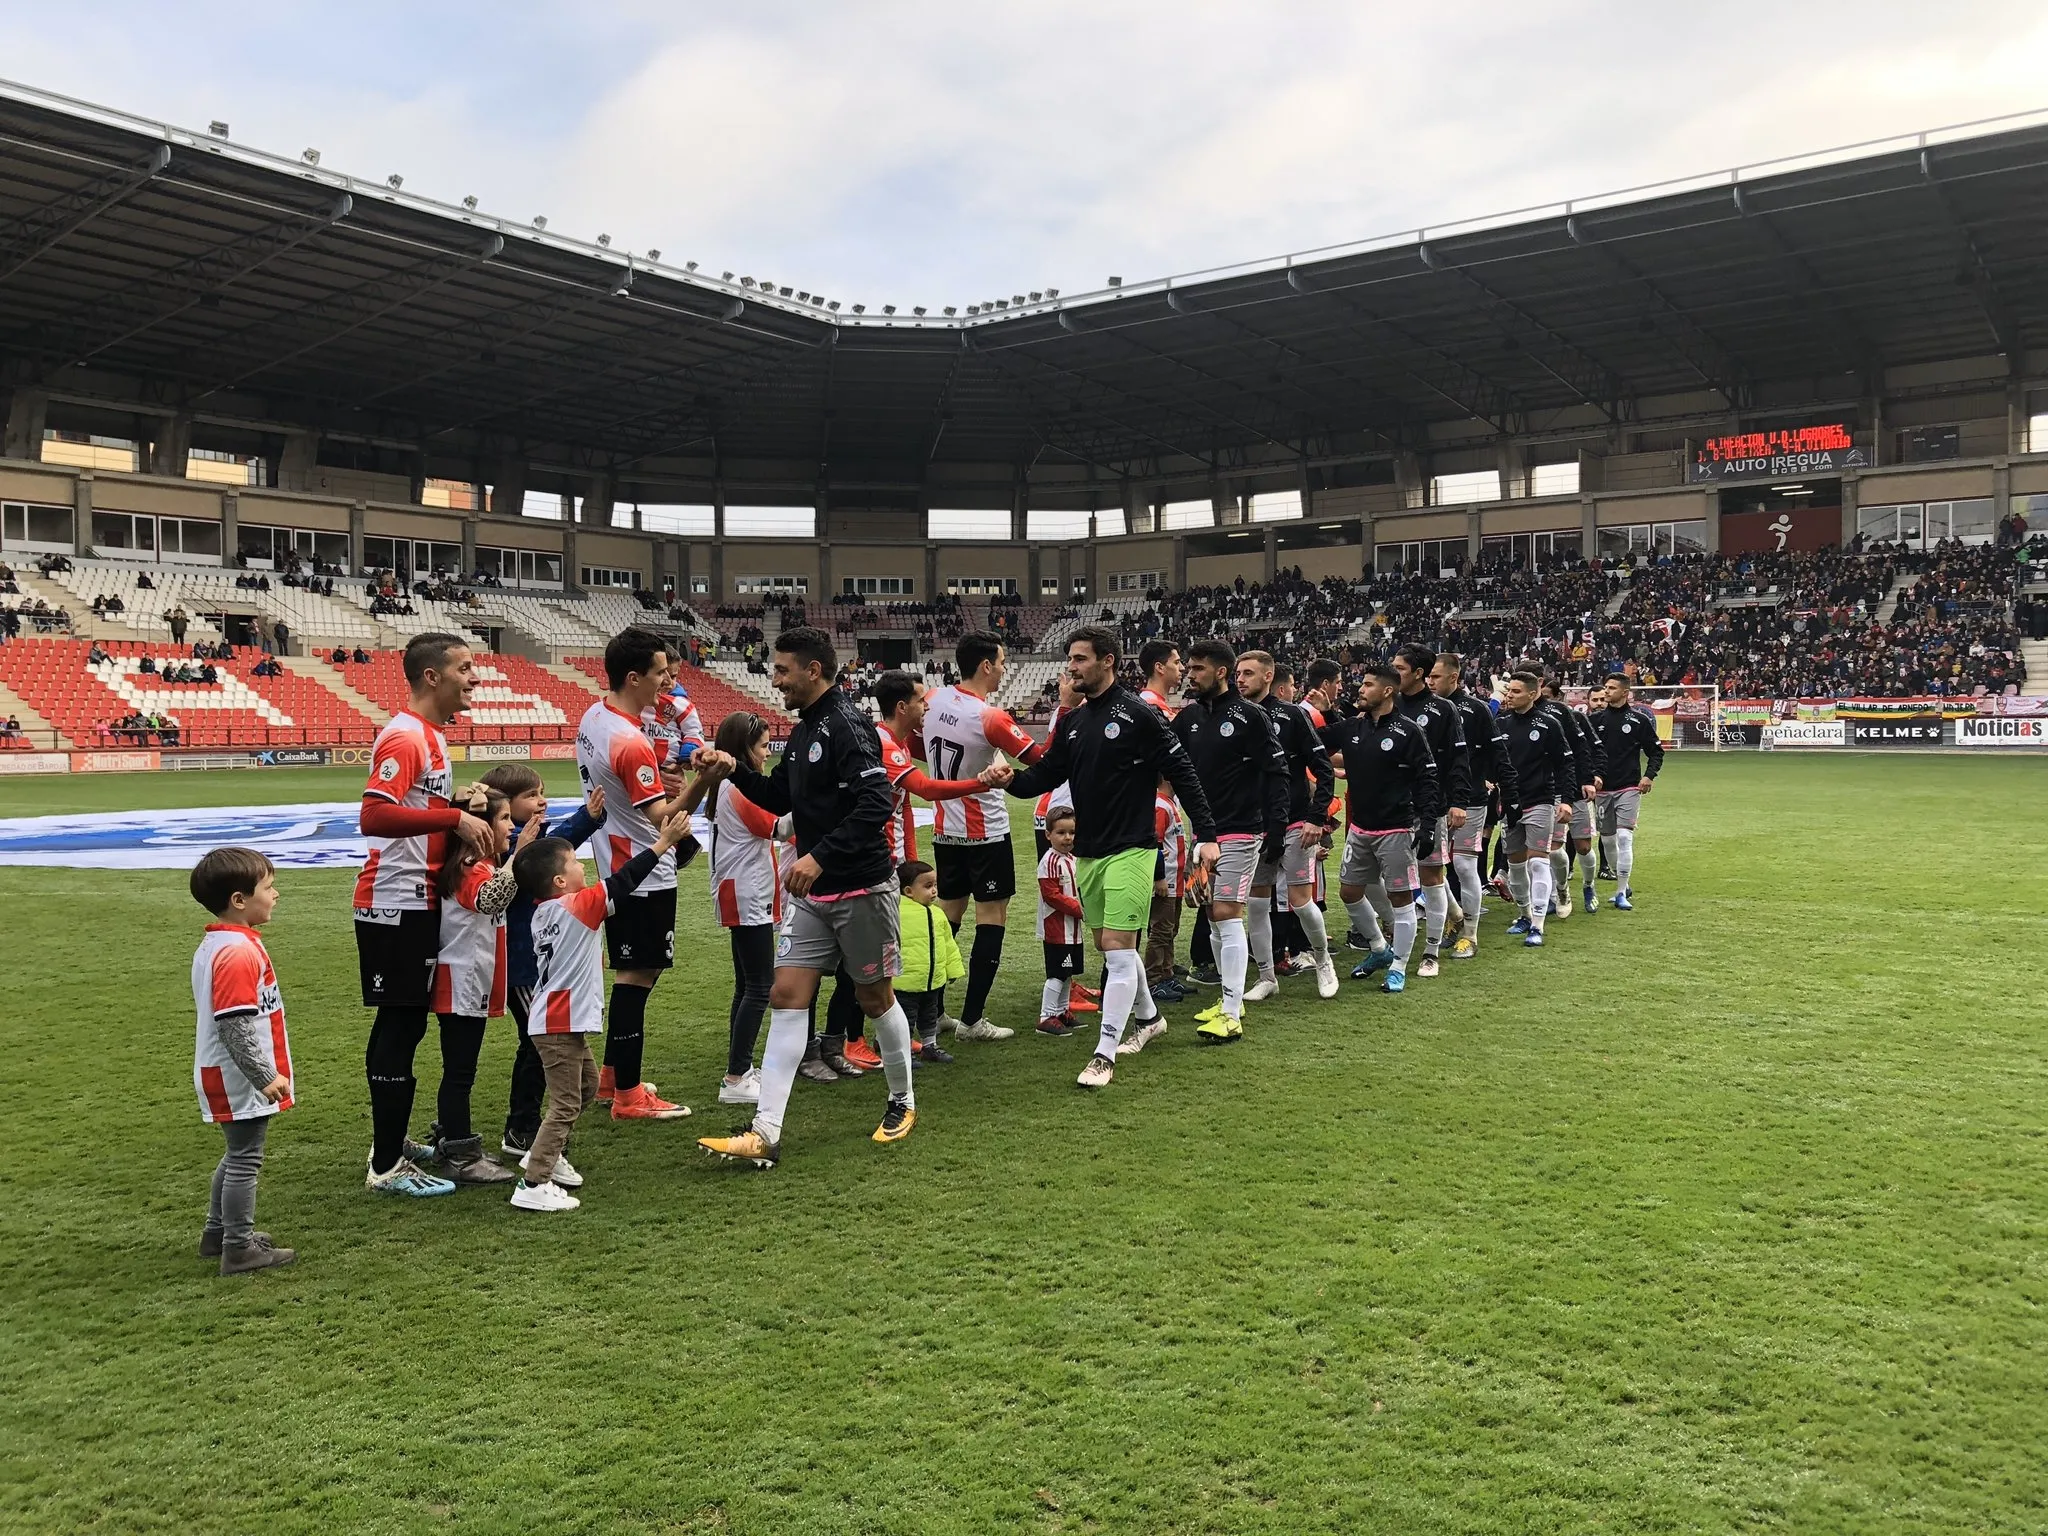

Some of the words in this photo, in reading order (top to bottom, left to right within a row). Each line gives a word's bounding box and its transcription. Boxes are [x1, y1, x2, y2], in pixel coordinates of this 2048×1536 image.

[1724, 458, 1767, 473] AUTO
[1771, 452, 1832, 468] IREGUA
[1838, 702, 1846, 710] EL
[1851, 703, 1878, 711] VILLAR
[1882, 704, 1893, 712] DE
[1897, 703, 1929, 712] ARNEDO
[938, 712, 960, 727] ANDY
[1764, 725, 1844, 738] peñaclara
[1855, 727, 1923, 737] KELME
[1963, 719, 2042, 736] Noticias
[276, 751, 320, 761] CaixaBank
[486, 745, 529, 755] TOBELOS
[929, 735, 965, 781] 17
[425, 958, 438, 993] 7
